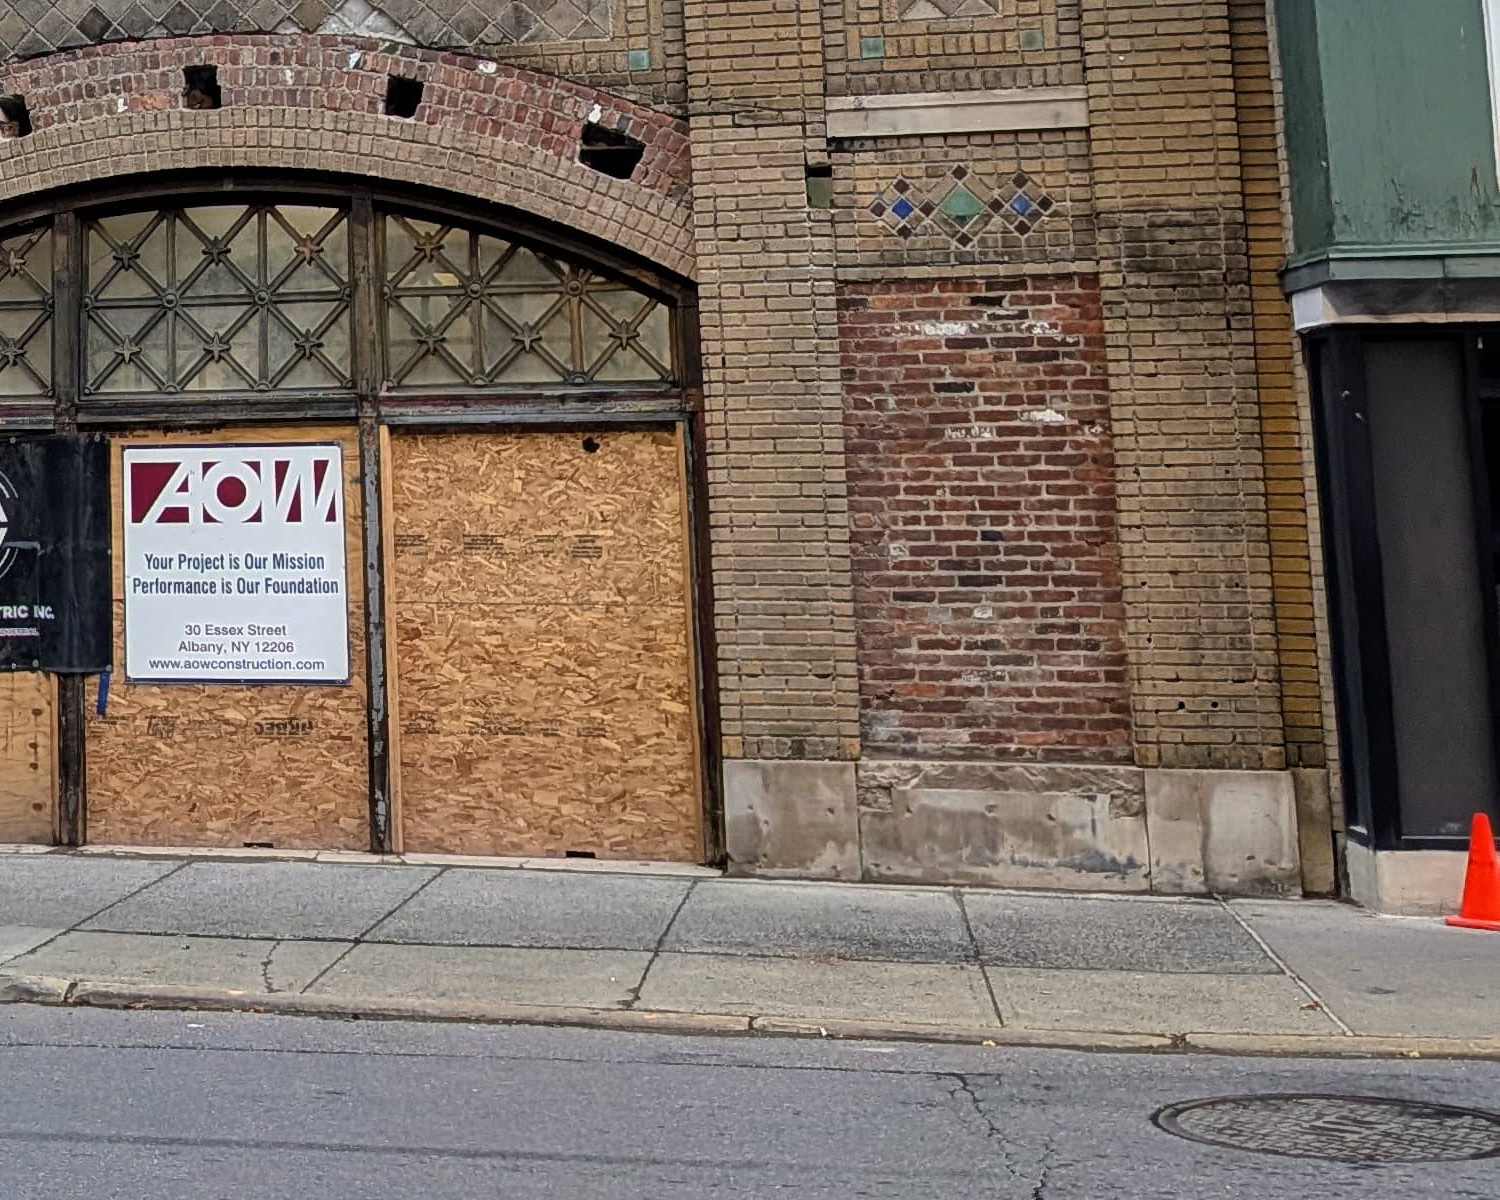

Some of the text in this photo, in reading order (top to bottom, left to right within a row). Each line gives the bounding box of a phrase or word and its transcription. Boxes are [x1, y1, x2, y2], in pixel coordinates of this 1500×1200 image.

[131, 459, 338, 523] AOW
[144, 552, 325, 574] Your Project is Our Mission
[132, 577, 339, 595] Performance is Our Foundation
[184, 624, 287, 636] 30 Essex Street
[178, 641, 294, 655] Albany, NY 12206
[149, 658, 325, 670] www.aowconstruction.com
